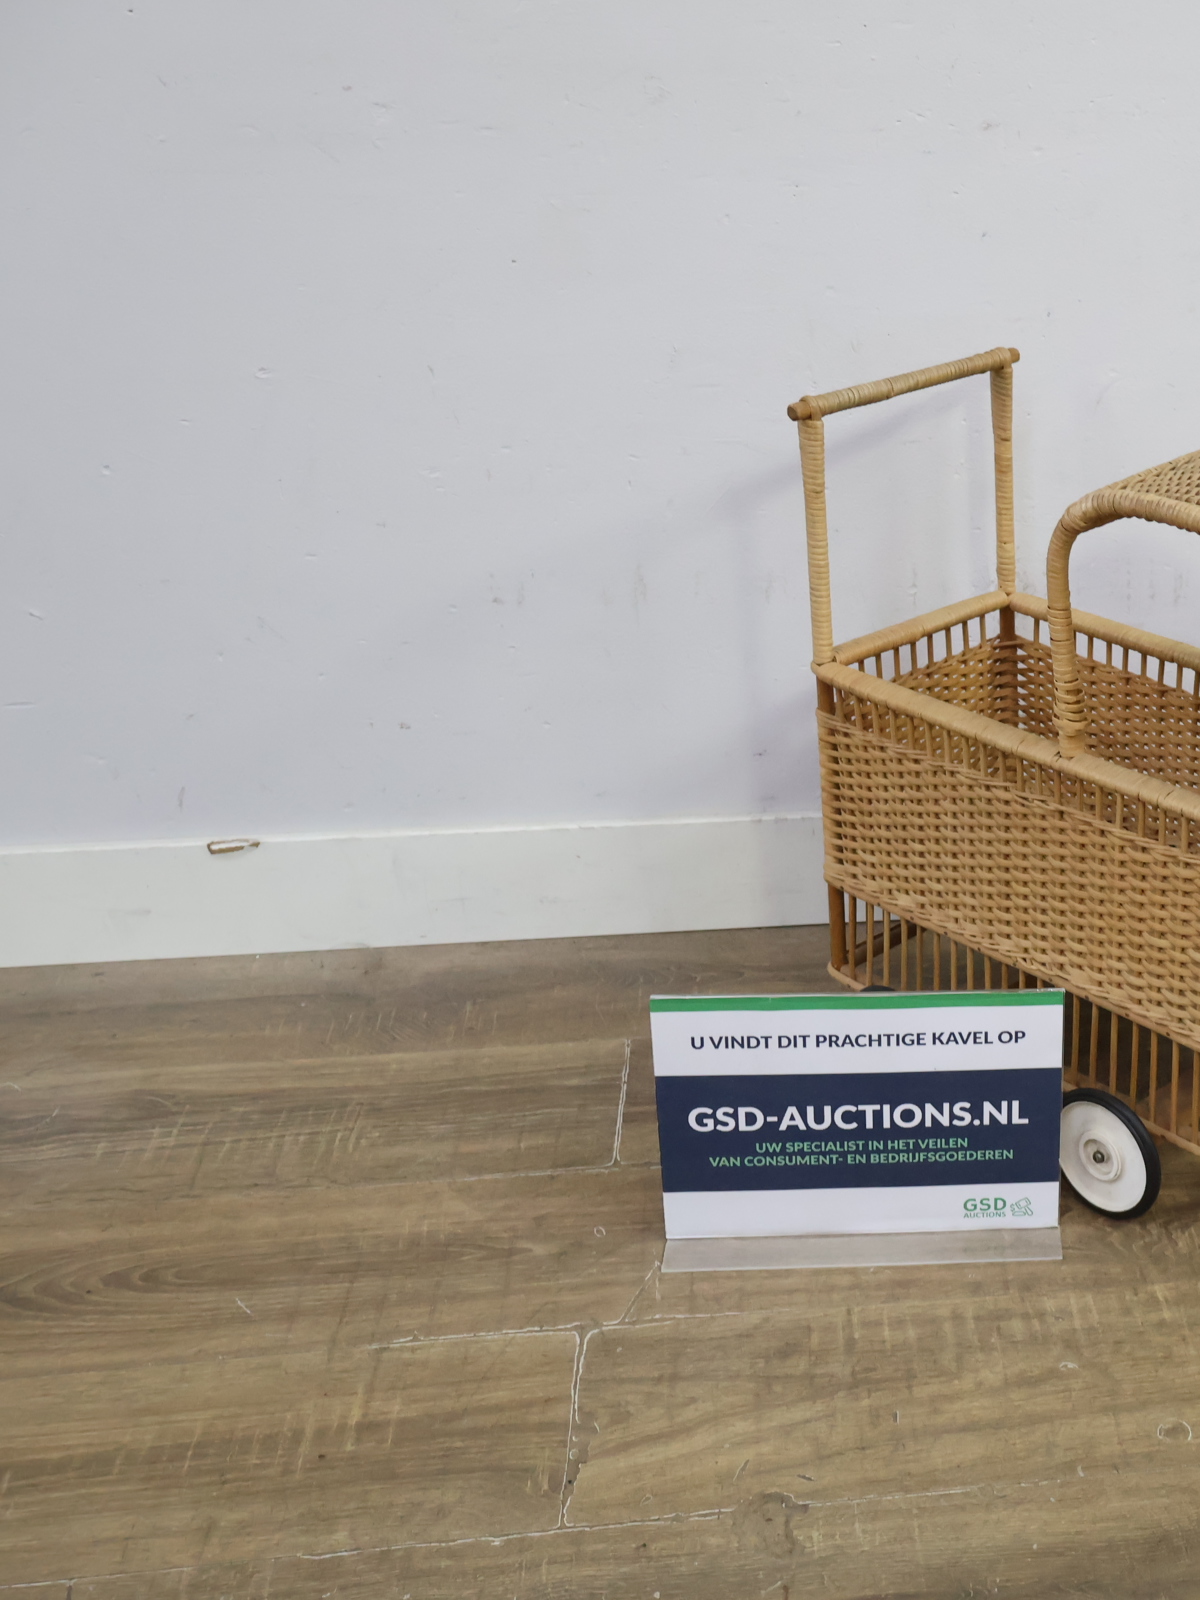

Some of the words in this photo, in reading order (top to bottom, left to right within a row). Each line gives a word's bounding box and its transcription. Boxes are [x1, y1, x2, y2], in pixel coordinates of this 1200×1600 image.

[691, 1036, 705, 1050] U
[709, 1035, 773, 1050] VINDT
[778, 1034, 810, 1048] DIT
[816, 1032, 926, 1048] PRACHTIGE
[932, 1031, 994, 1045] KAVEL
[998, 1030, 1026, 1045] OP
[688, 1100, 1029, 1132] GSD-AUCTIONS.NL
[756, 1142, 782, 1153] UW
[786, 1140, 865, 1152] SPECIALIST
[868, 1140, 883, 1151] IN
[888, 1139, 916, 1150] HET
[918, 1137, 968, 1149] VEILEN
[709, 1156, 741, 1167] VAN
[744, 1154, 843, 1167] CONSUMENT-
[847, 1153, 866, 1164] EN
[870, 1149, 1013, 1164] BEDRIJFSGOEDEREN
[963, 1197, 1007, 1212] GSD
[963, 1211, 1006, 1219] AUCTIONS
